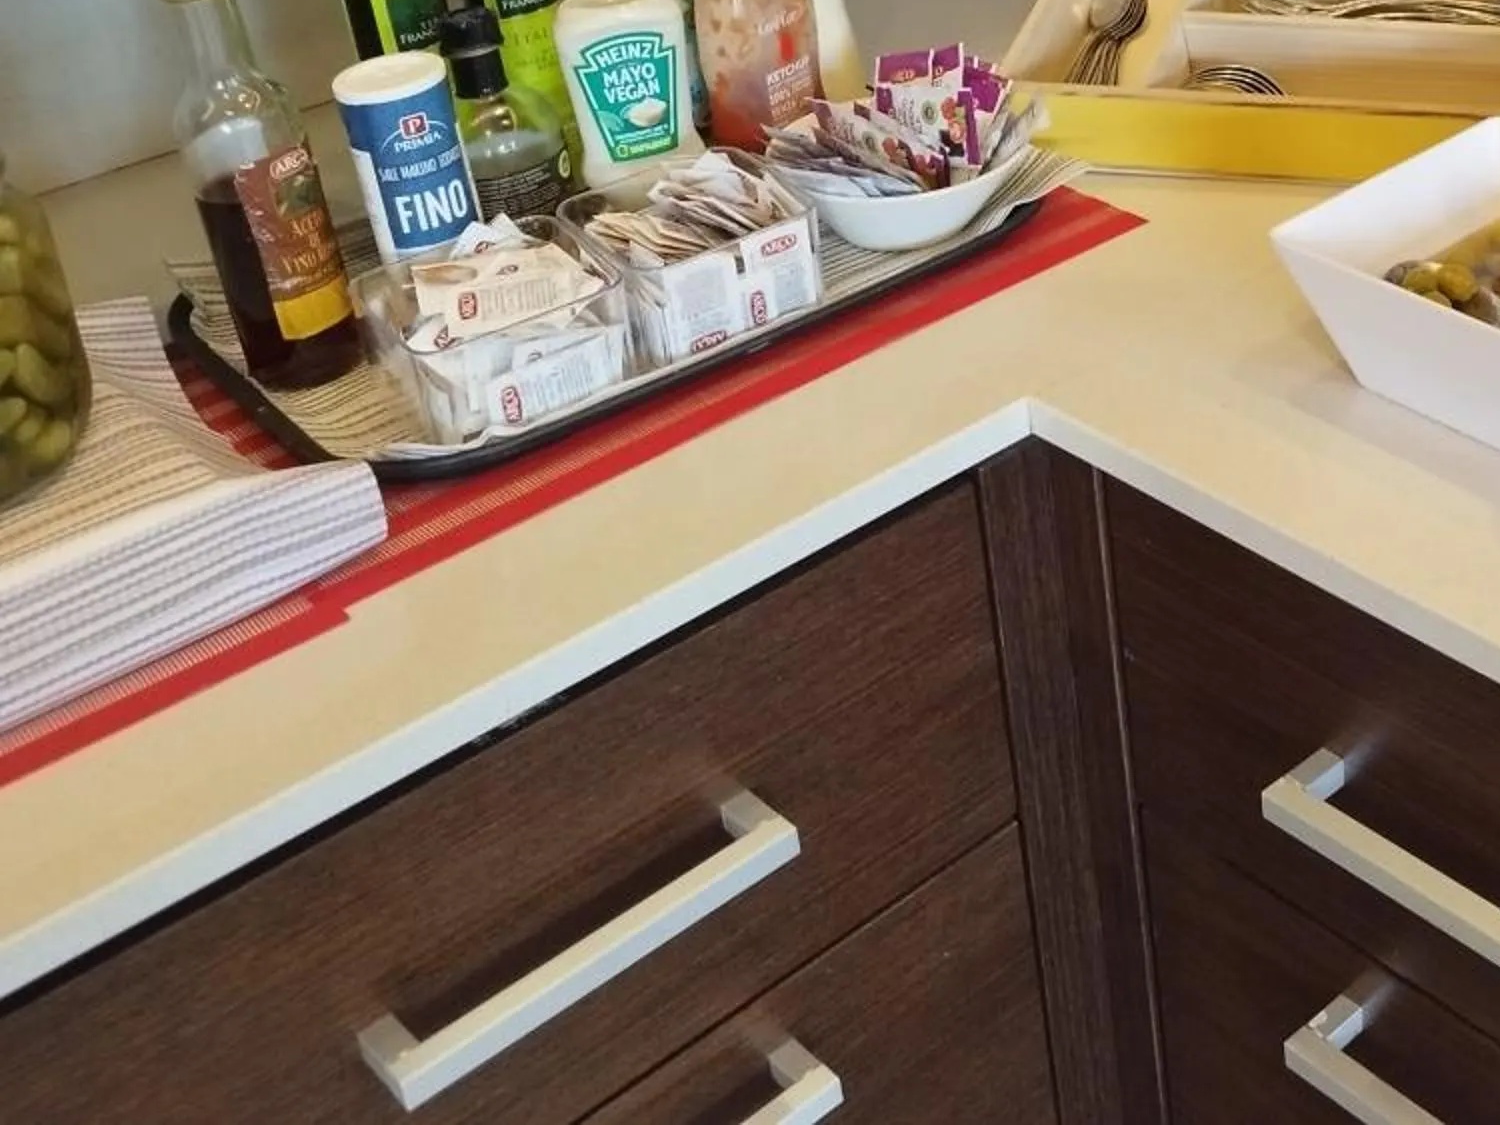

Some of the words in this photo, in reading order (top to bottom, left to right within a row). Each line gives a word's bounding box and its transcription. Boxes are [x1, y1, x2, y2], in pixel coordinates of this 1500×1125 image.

[596, 42, 653, 68] HEINZ
[603, 62, 656, 88] MAYO
[603, 78, 661, 104] VEGAN
[395, 178, 468, 234] FINO
[761, 234, 797, 256] ARCO
